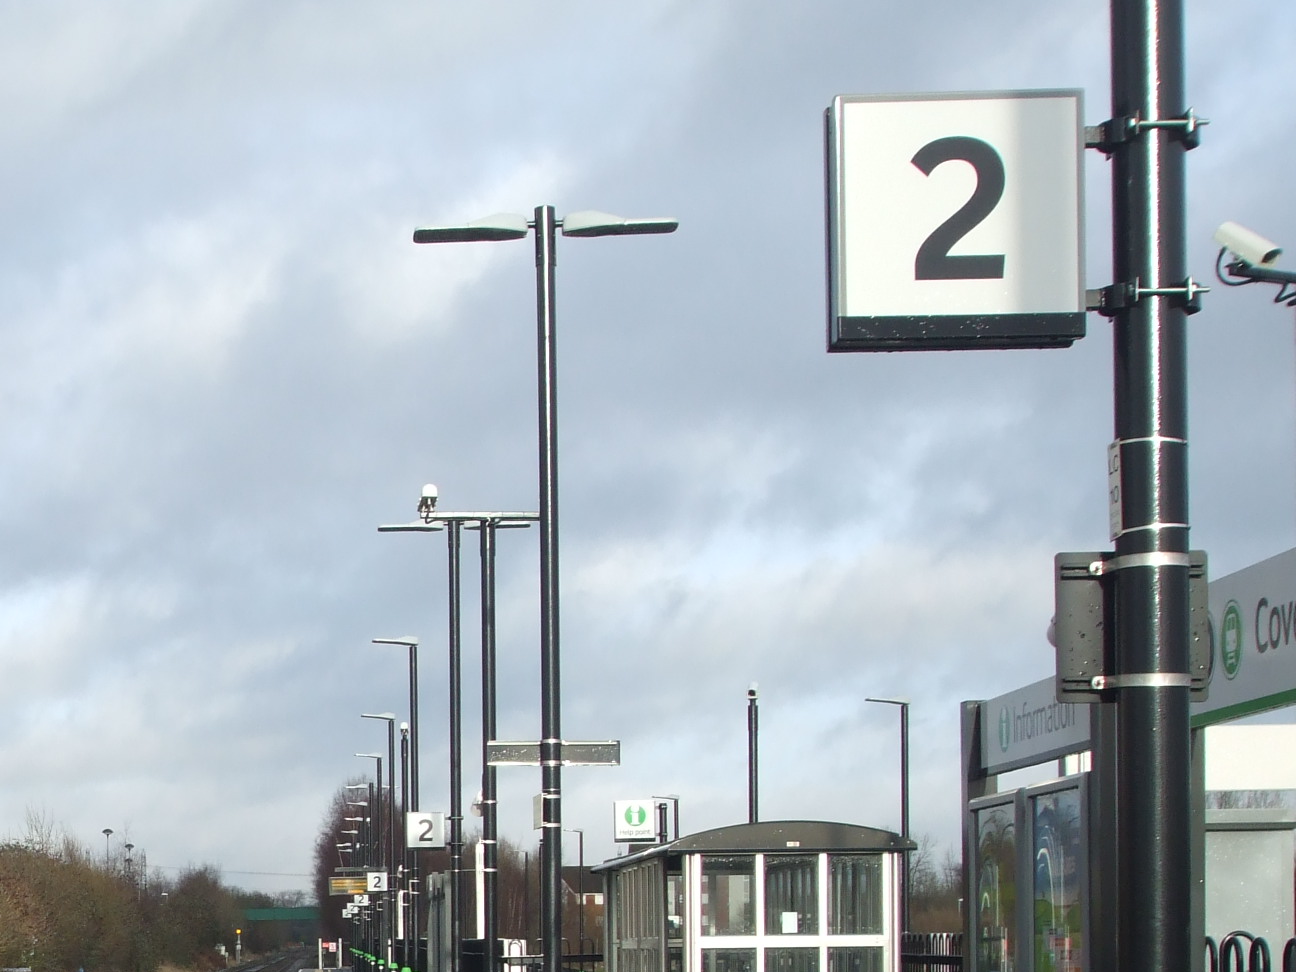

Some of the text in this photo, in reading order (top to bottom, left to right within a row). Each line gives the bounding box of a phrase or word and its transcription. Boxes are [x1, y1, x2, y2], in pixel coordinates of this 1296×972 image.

[910, 135, 1006, 281] 2
[1255, 596, 1296, 654] Cov
[1013, 696, 1076, 744] Information
[418, 818, 434, 842] 2
[358, 894, 365, 904] 2
[373, 875, 382, 888] 2
